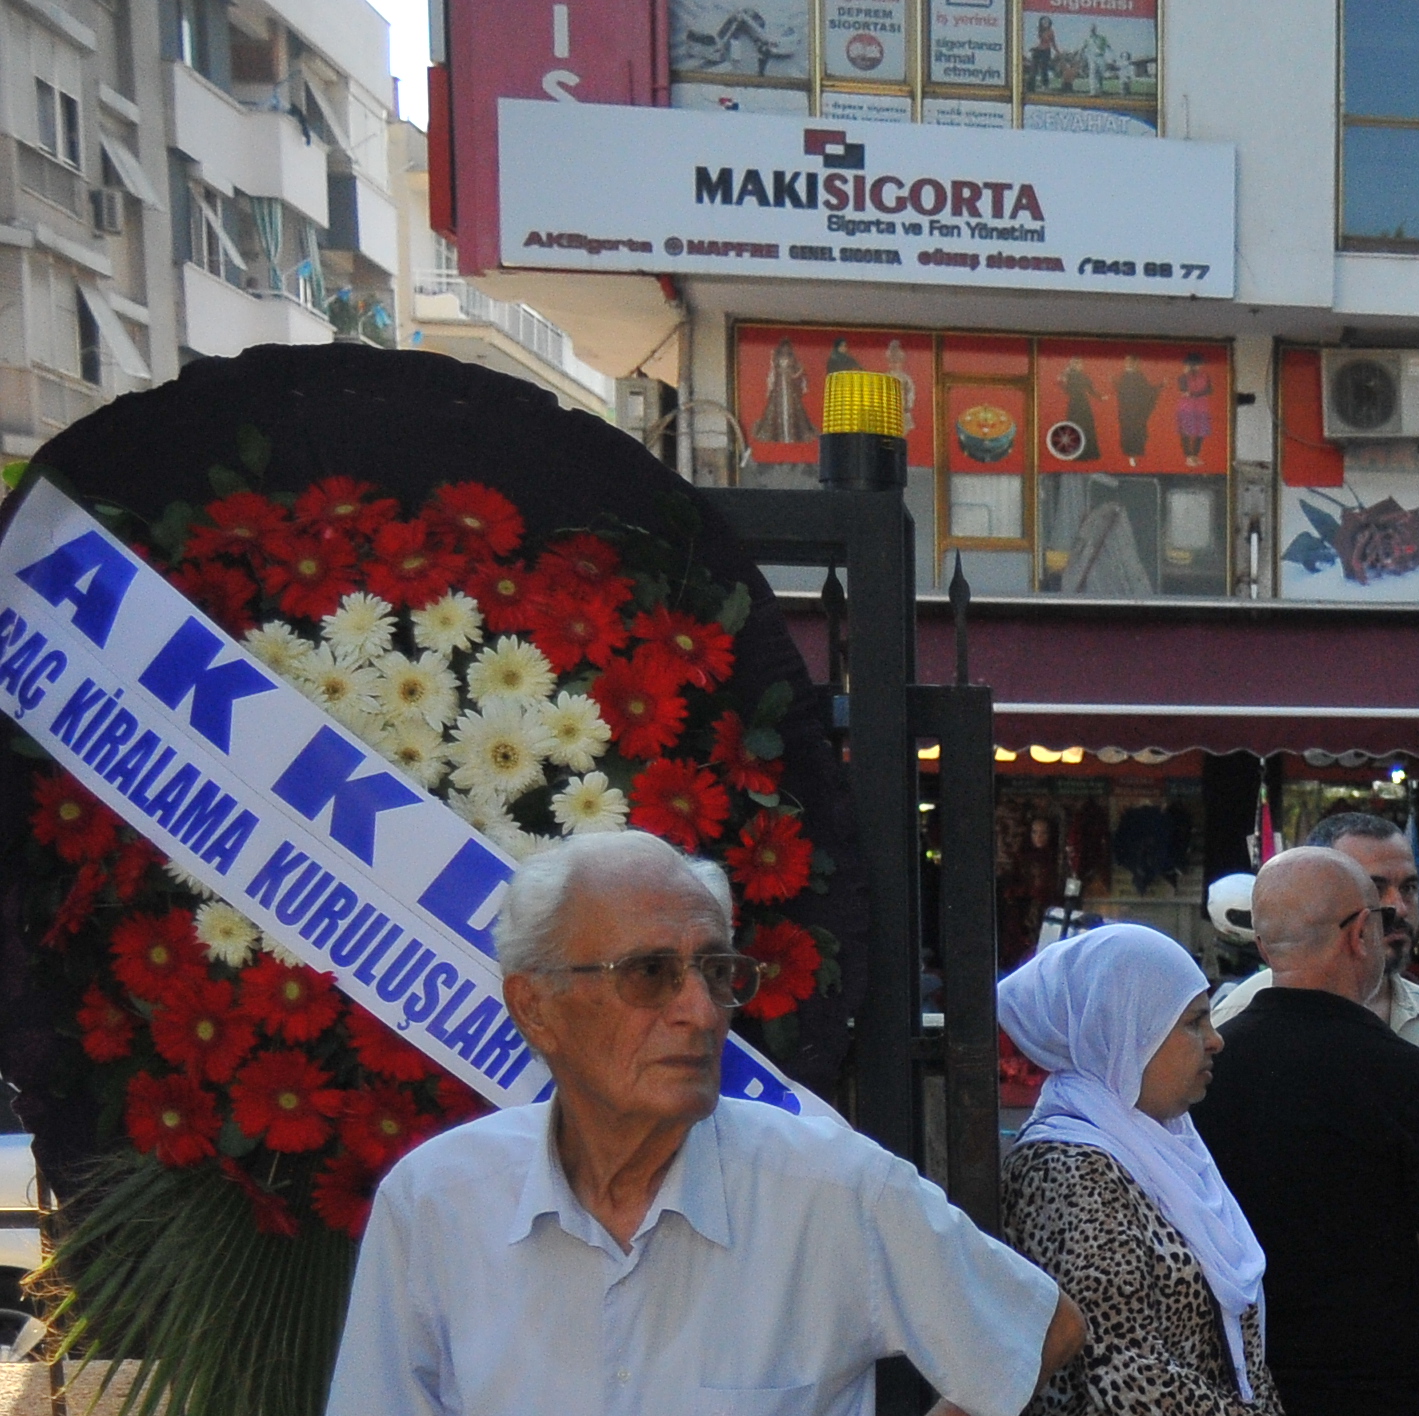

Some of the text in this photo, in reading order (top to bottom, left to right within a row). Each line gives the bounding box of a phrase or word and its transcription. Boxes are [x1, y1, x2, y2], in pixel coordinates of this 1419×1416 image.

[837, 7, 893, 19] DEPREM
[935, 52, 976, 65] ihmal
[943, 66, 1000, 81] etmeyin
[827, 214, 1046, 242] Sigorta ve Fon Yönetimi
[1179, 263, 1211, 280] 77
[49, 677, 260, 876] KİRALAMA
